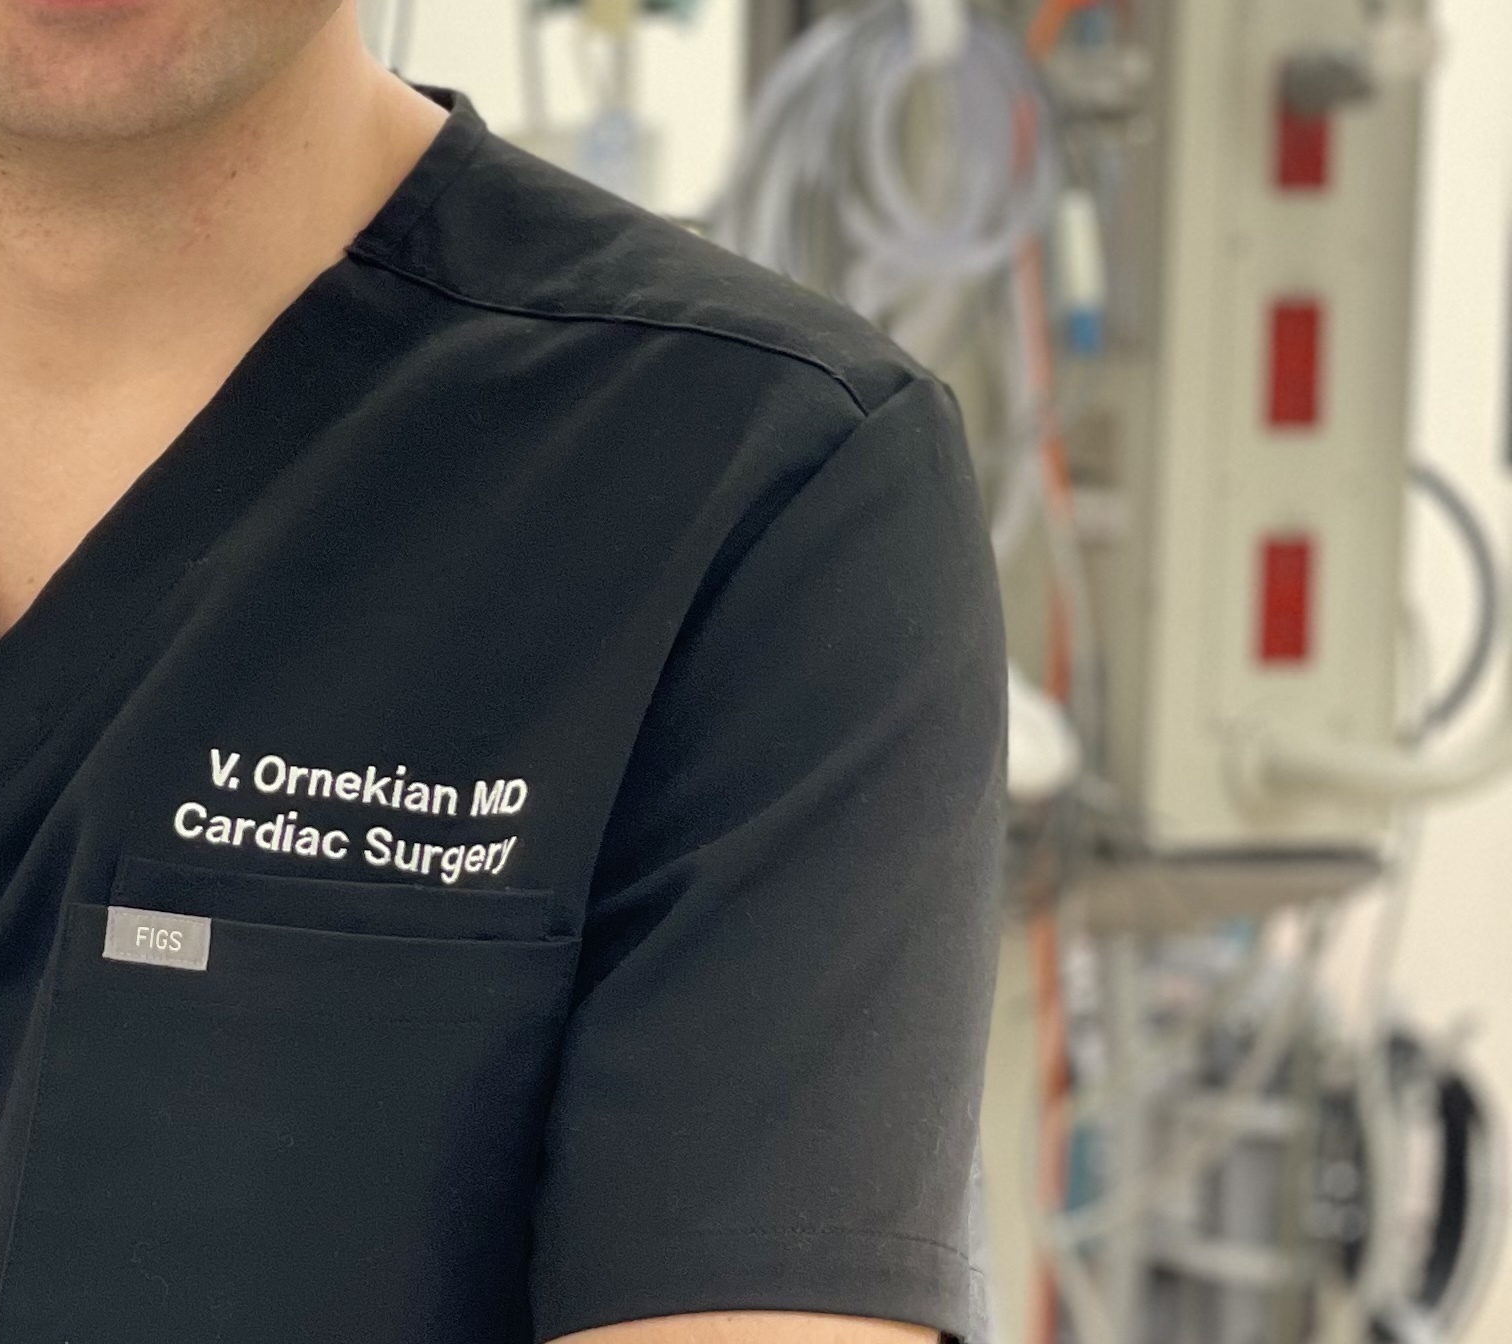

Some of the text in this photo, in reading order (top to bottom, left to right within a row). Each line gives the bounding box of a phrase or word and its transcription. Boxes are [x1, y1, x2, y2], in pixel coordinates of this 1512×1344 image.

[210, 748, 528, 817] V. Ornekian MD
[173, 801, 518, 885] Cardiac Surgery
[135, 926, 184, 952] FIGS
